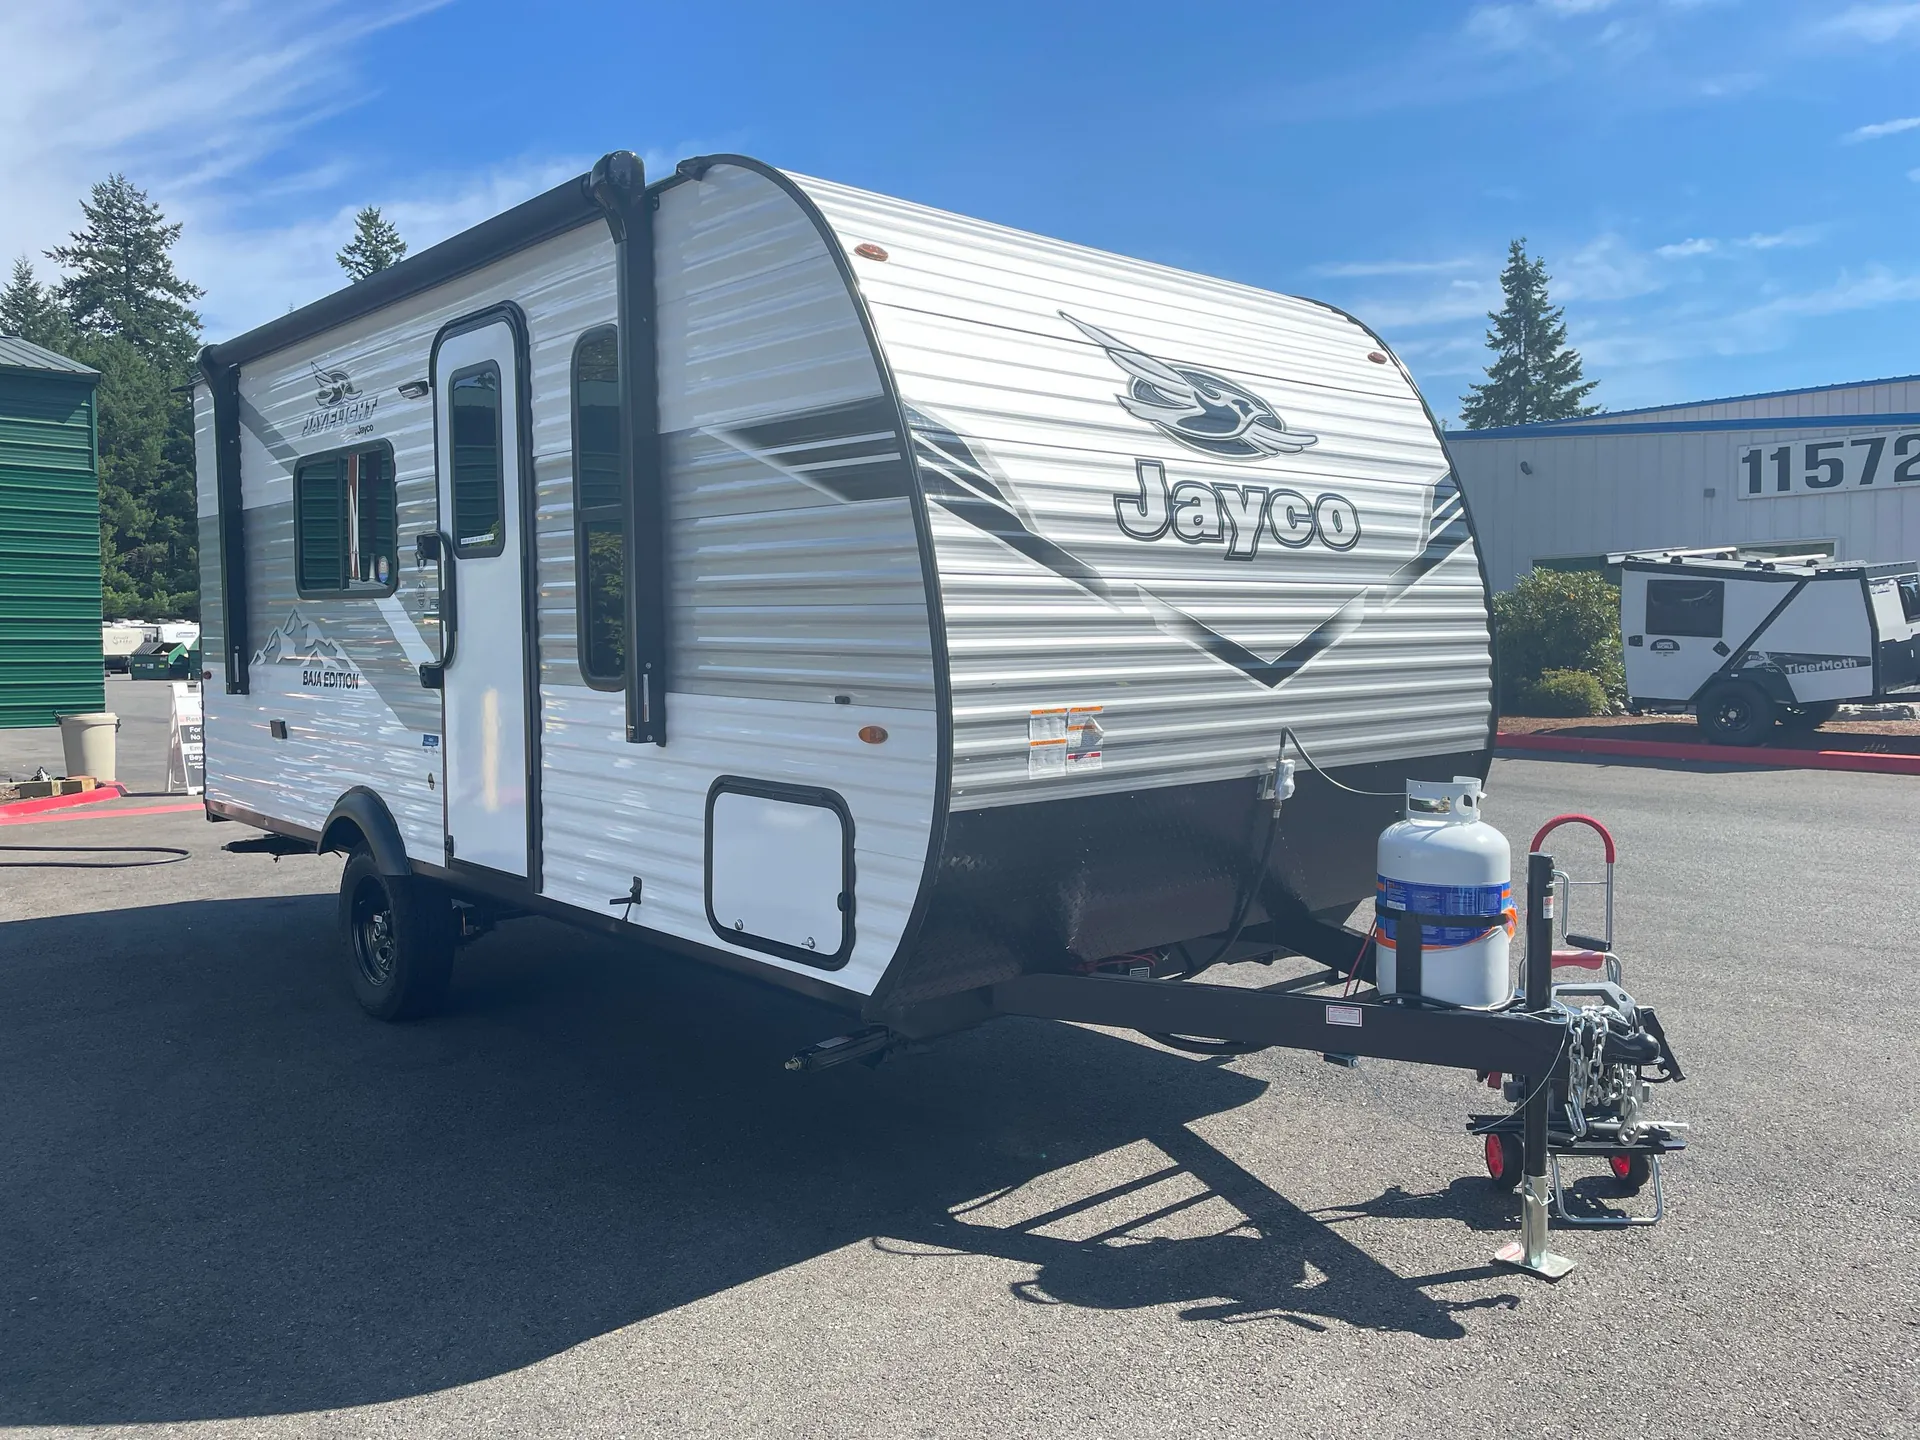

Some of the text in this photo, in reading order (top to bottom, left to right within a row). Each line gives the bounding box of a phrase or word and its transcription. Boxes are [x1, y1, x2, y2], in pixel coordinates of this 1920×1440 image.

[357, 424, 374, 435] Jayco
[1741, 433, 1920, 494] 11572
[1113, 457, 1361, 561] Jayco
[1785, 658, 1857, 674] TigerMoth
[303, 670, 359, 690] BAJA EDITION
